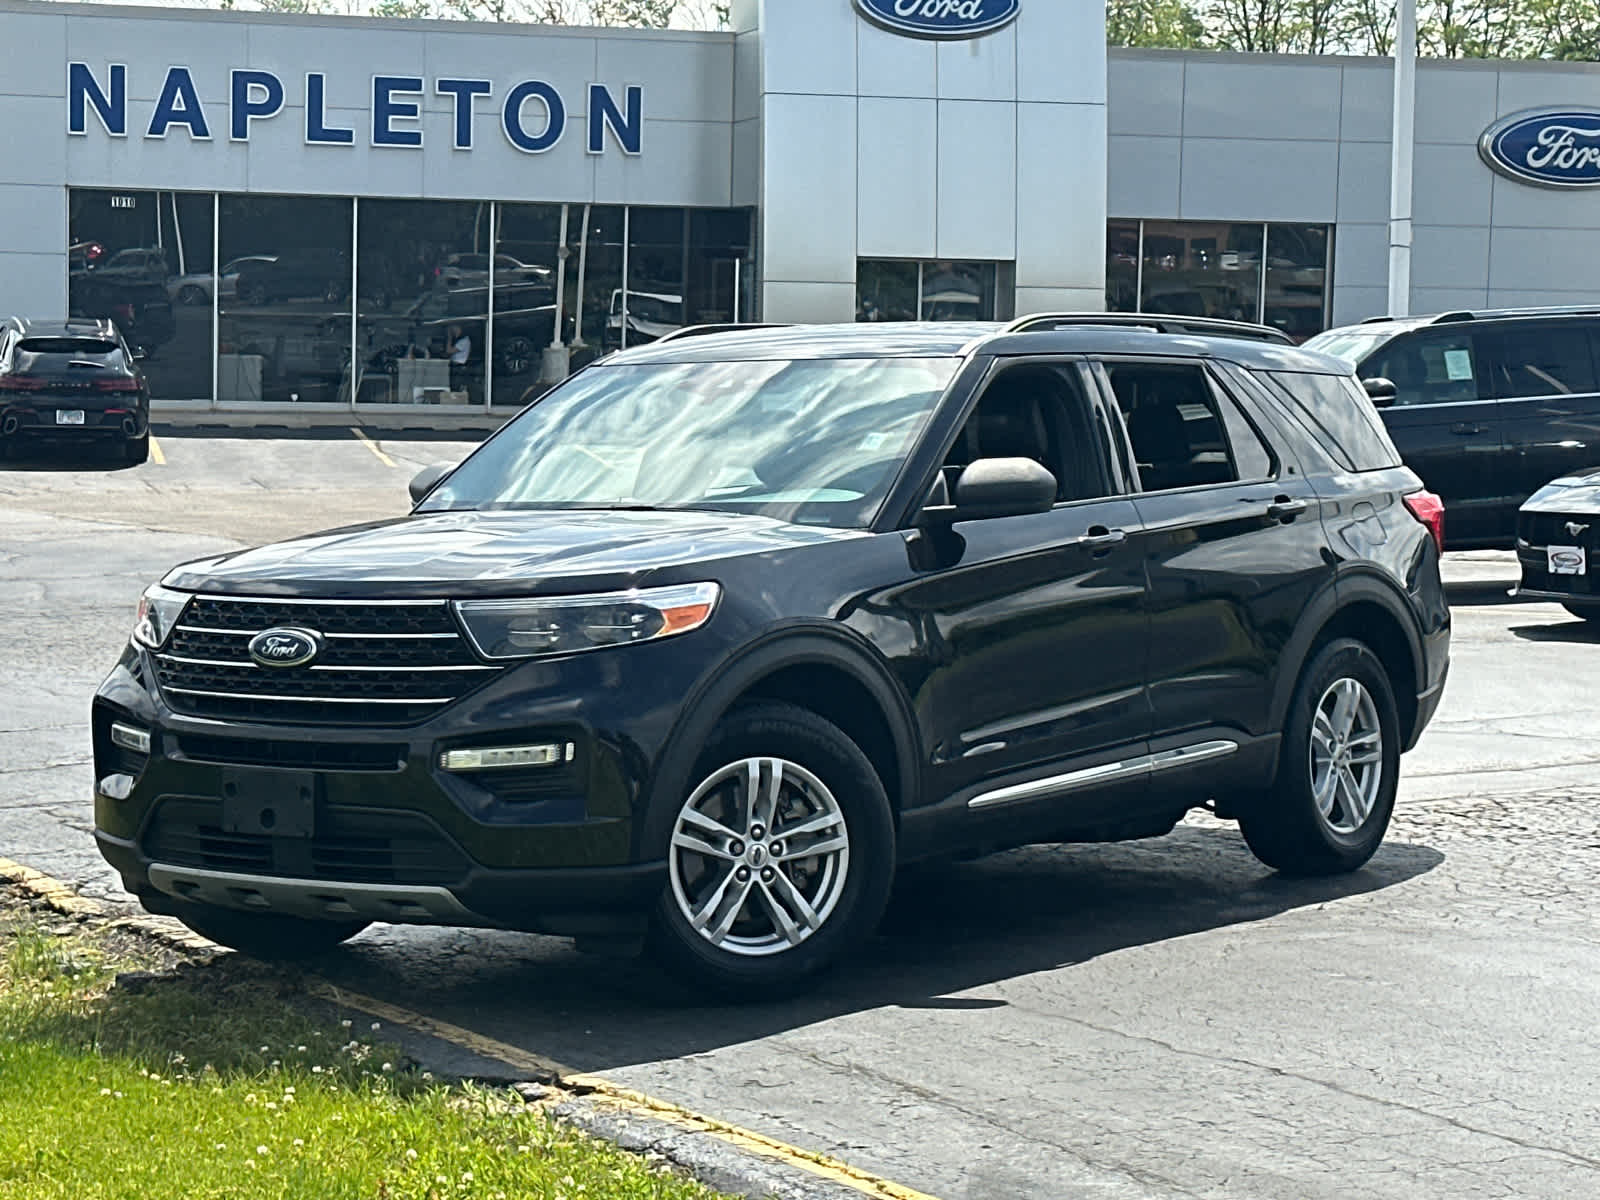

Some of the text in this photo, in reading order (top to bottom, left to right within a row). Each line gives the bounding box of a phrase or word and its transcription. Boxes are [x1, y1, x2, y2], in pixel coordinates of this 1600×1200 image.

[66, 61, 644, 155] NAPLETON
[1526, 125, 1600, 169] For
[112, 197, 135, 208] 1010
[262, 637, 299, 657] Ford
